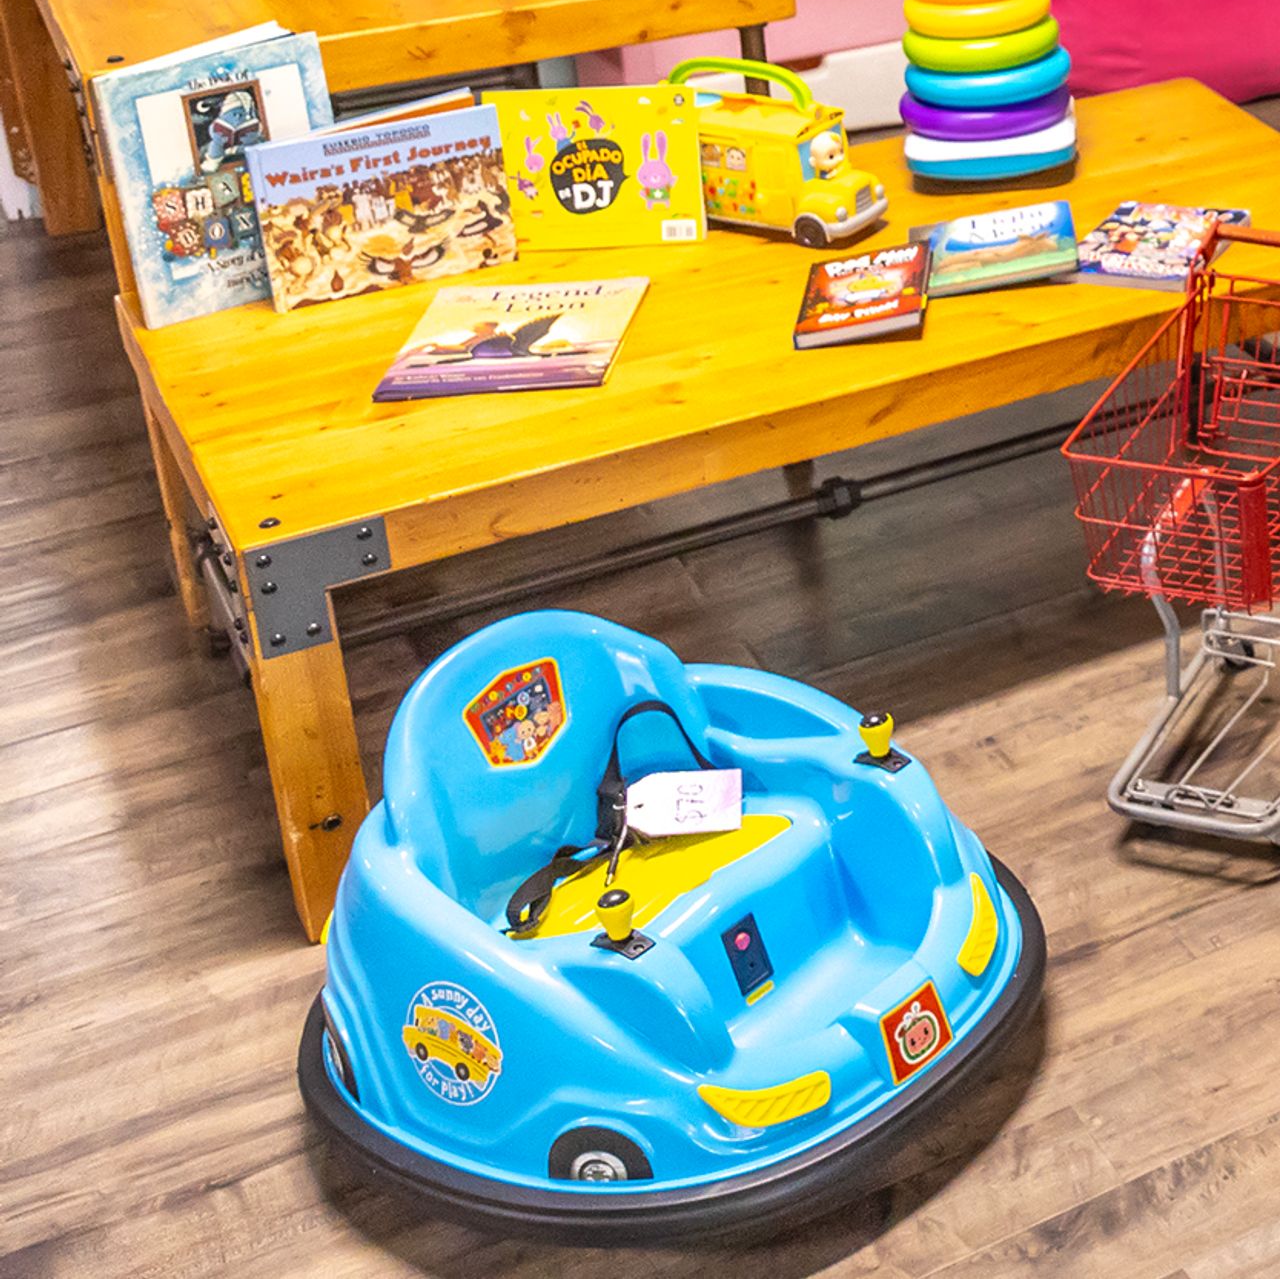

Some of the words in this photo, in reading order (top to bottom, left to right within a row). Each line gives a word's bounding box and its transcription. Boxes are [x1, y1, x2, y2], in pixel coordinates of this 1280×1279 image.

[265, 163, 345, 188] Waira's
[349, 149, 402, 173] First
[407, 134, 492, 163] Journey
[551, 147, 622, 175] OCUPADO
[572, 180, 614, 209] DJ
[492, 285, 603, 303] Legend
[431, 988, 469, 1010] sunny
[465, 1004, 492, 1032] day
[420, 1063, 439, 1086] for
